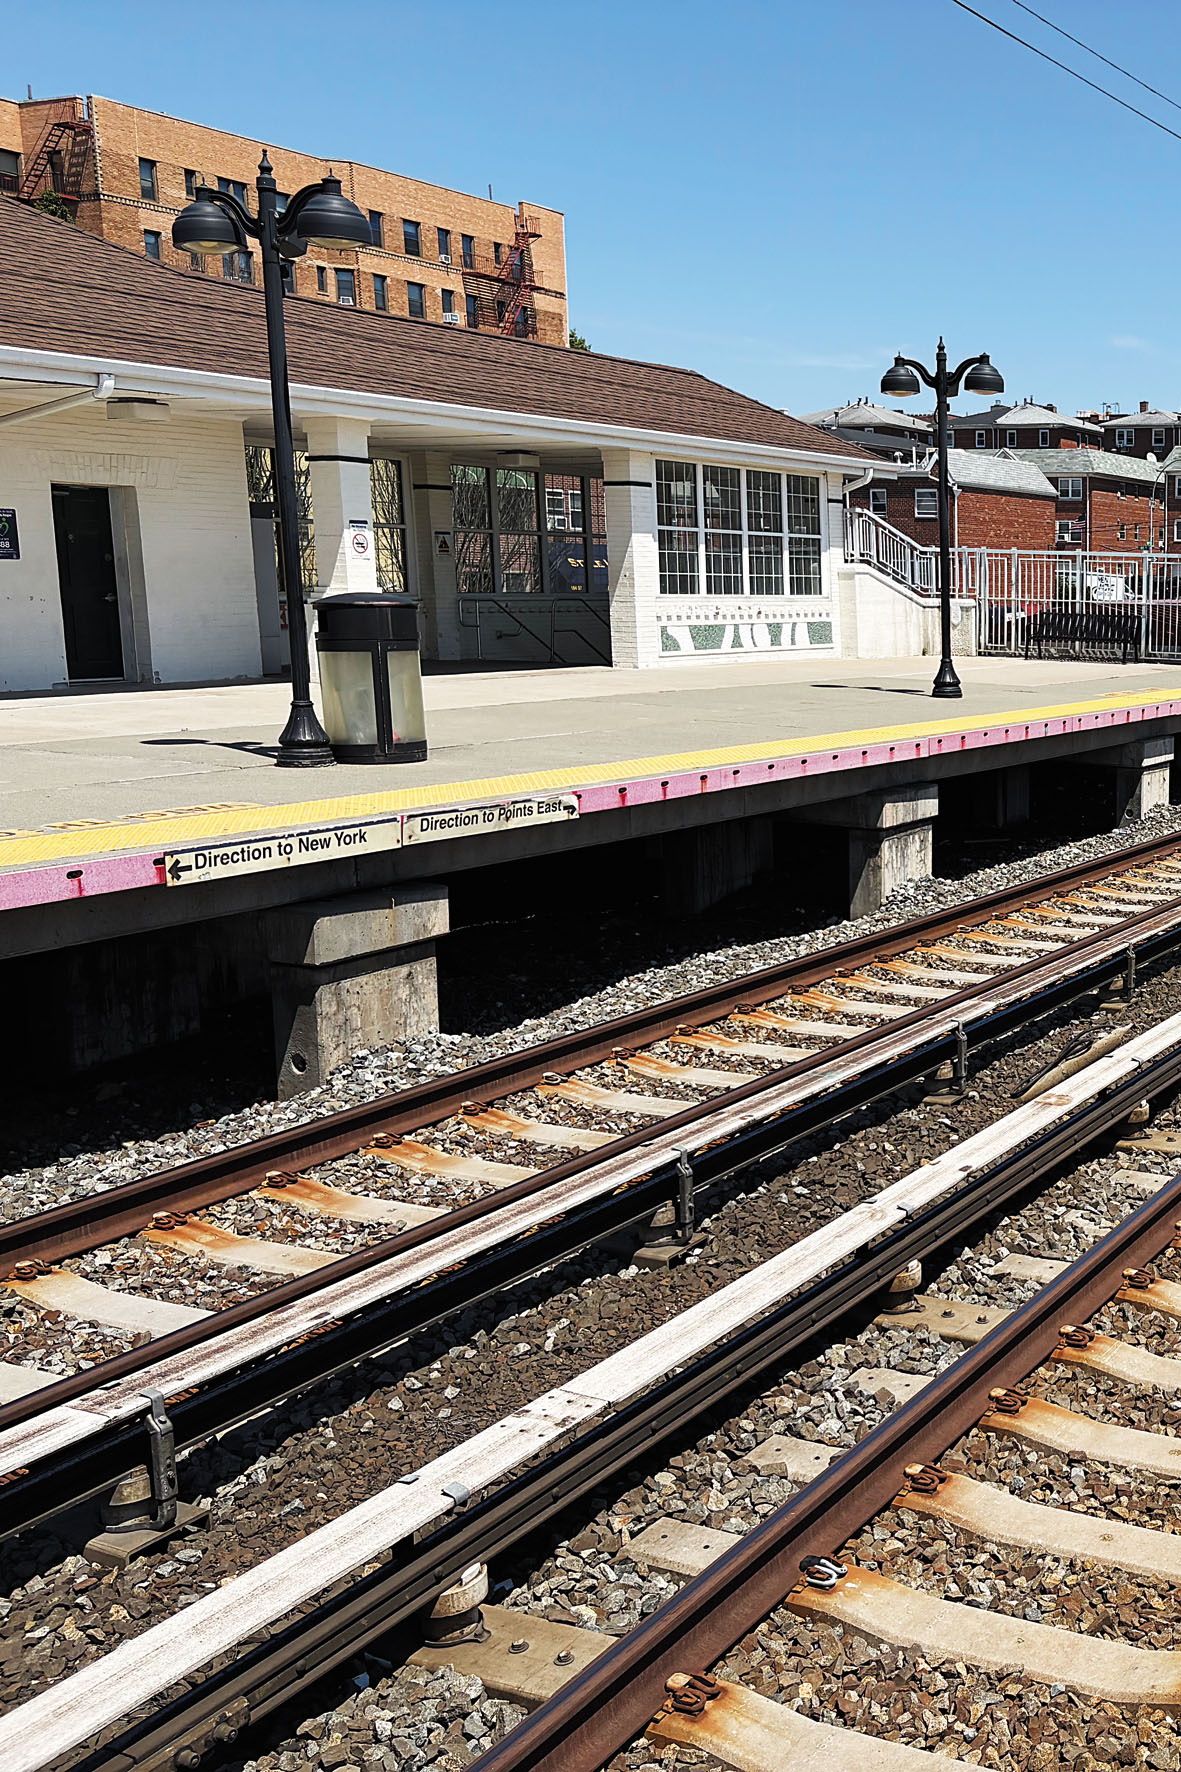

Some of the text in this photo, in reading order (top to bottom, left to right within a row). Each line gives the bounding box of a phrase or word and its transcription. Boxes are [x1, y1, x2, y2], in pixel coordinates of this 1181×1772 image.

[420, 799, 562, 832] Direction to Points East
[194, 828, 368, 870] Direction to New York
